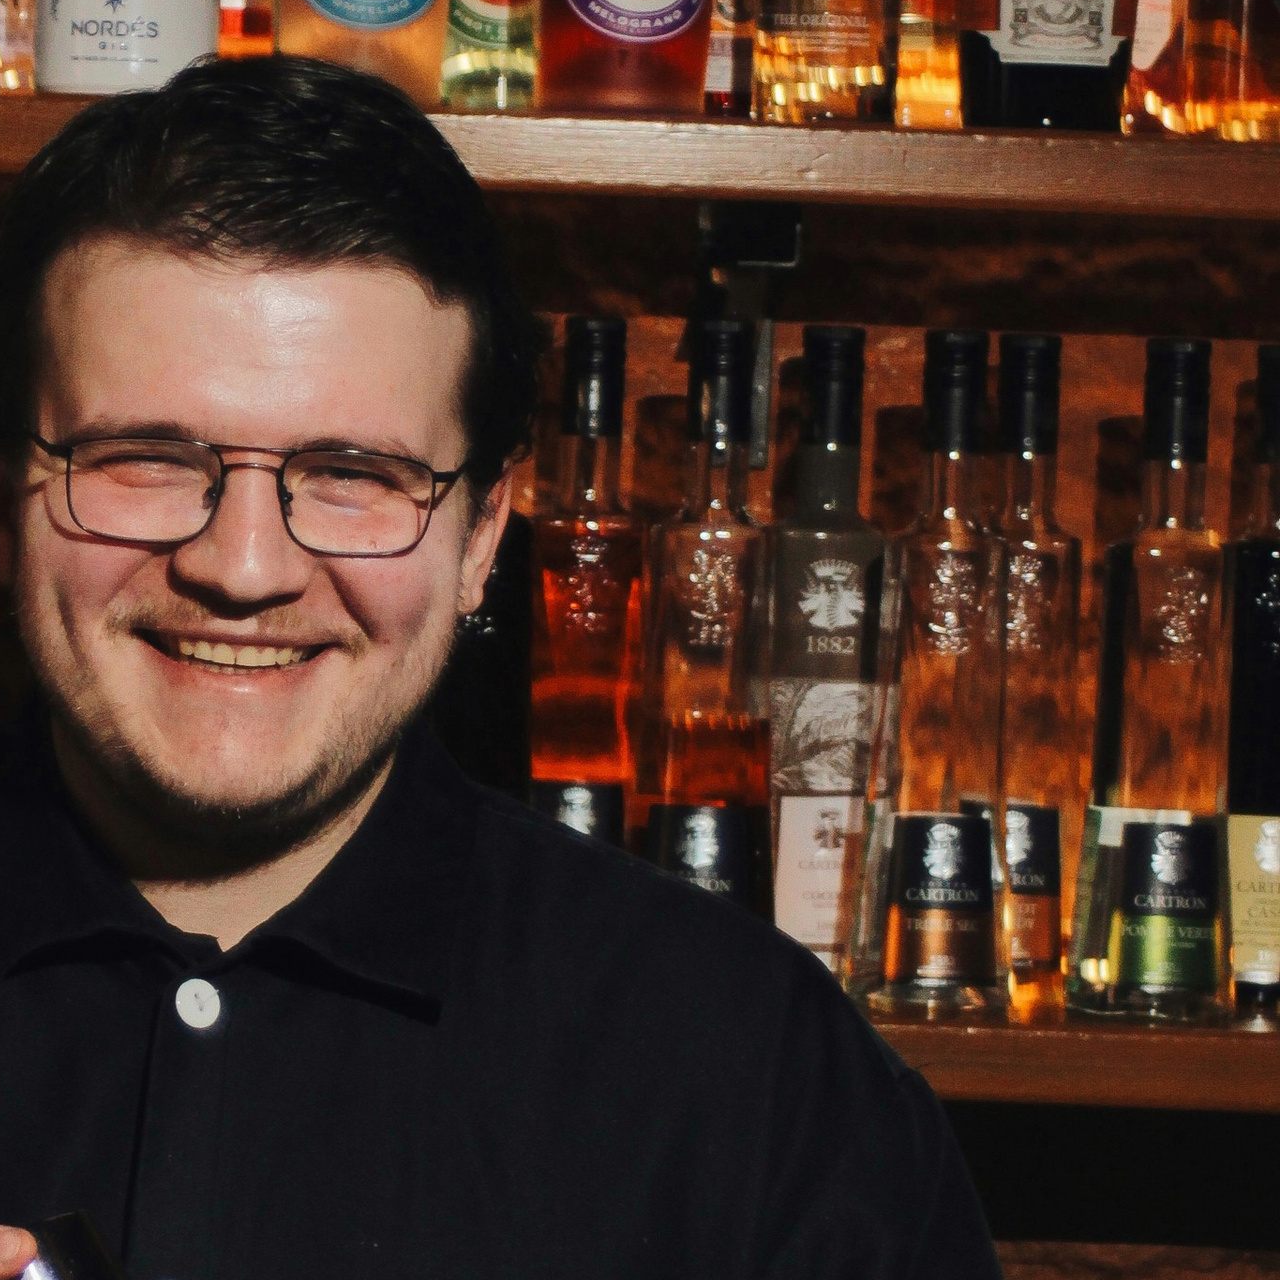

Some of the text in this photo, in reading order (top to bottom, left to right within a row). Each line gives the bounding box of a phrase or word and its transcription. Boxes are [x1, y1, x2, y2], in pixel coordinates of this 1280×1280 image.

[588, 1, 683, 29] MELOGRANO
[70, 17, 159, 39] NORDÉS
[806, 634, 856, 655] 1882
[905, 887, 980, 902] CARTRON
[1133, 893, 1207, 909] CARTRON
